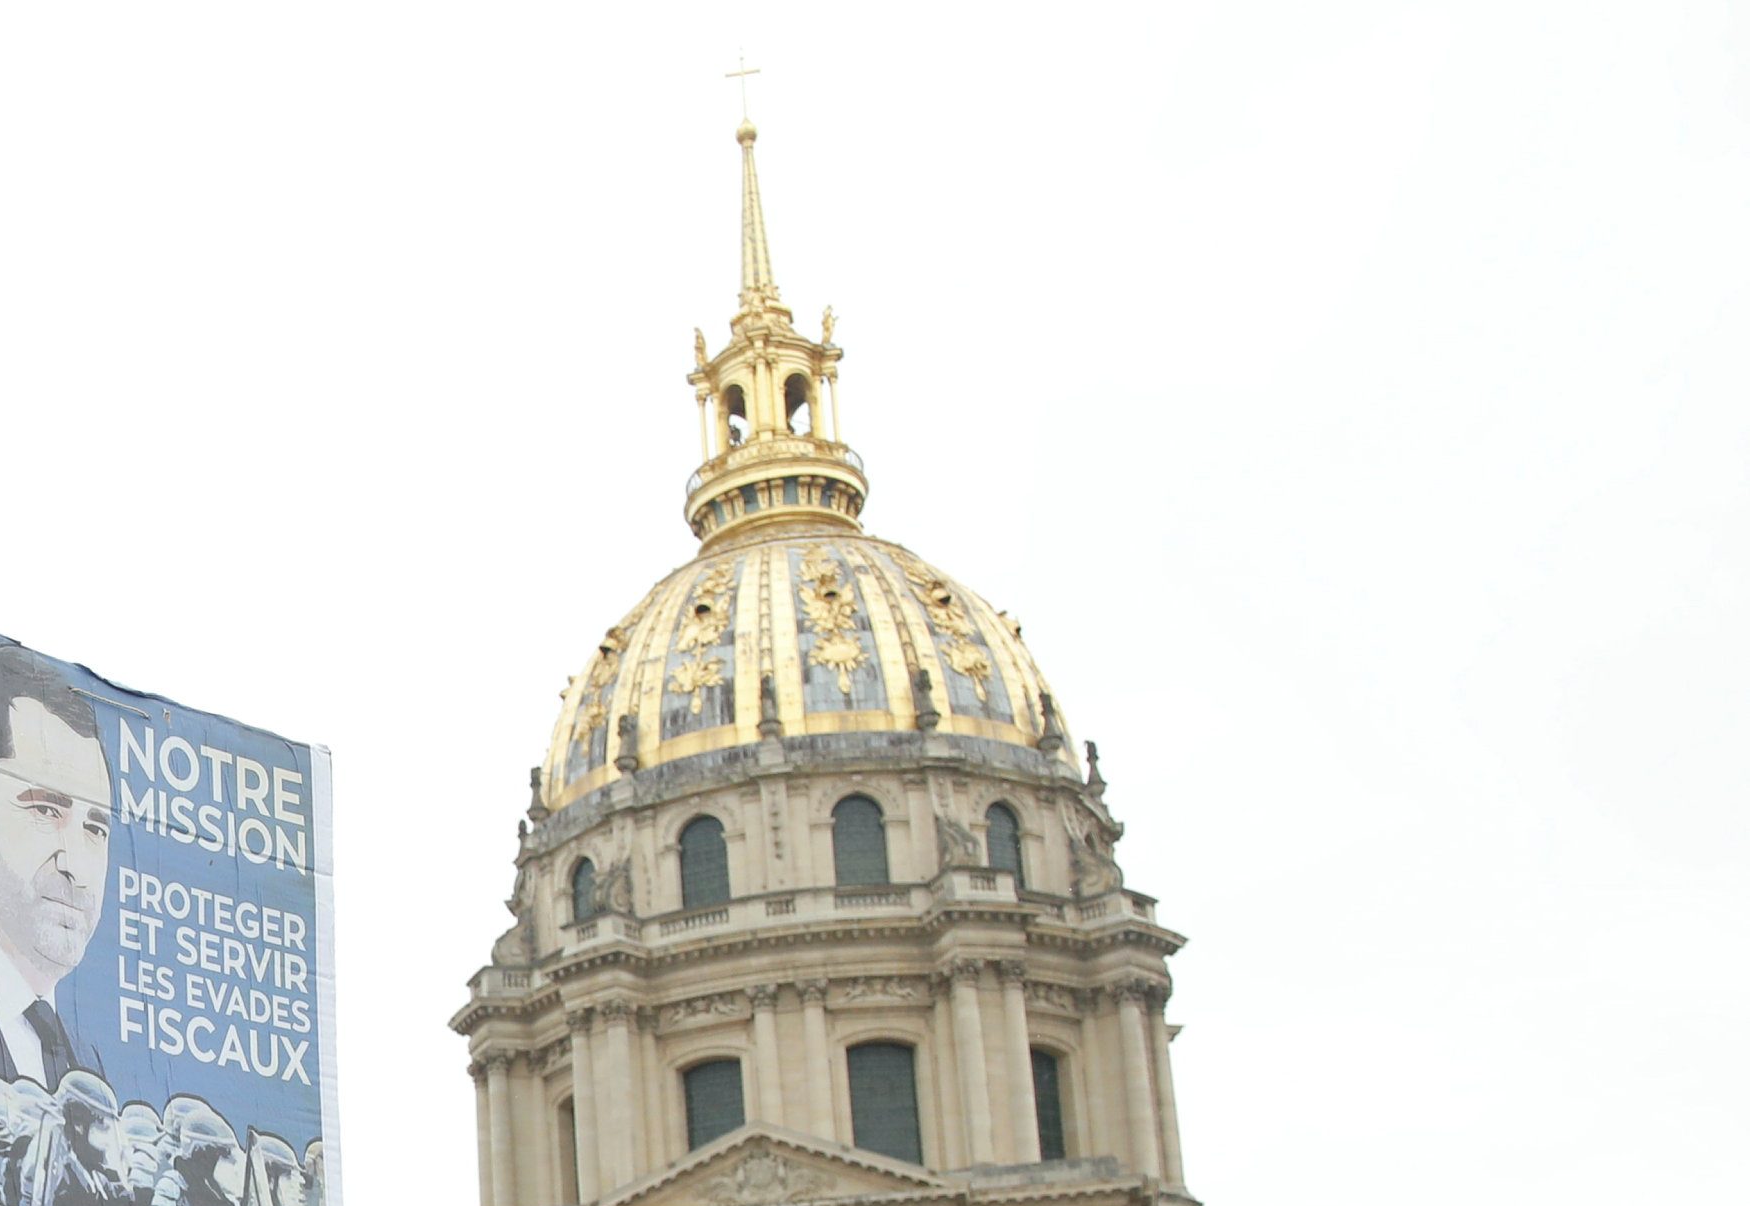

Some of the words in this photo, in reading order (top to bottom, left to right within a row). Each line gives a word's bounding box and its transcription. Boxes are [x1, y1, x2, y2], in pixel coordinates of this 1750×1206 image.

[120, 717, 306, 827] NOTRE
[119, 778, 308, 877] MISSION
[118, 865, 308, 951] PROTEGER
[118, 908, 164, 956] ET
[175, 925, 309, 994] SERVIR
[118, 954, 176, 1001] LES
[186, 973, 312, 1034] EVADES
[119, 995, 313, 1087] FISCAUX
